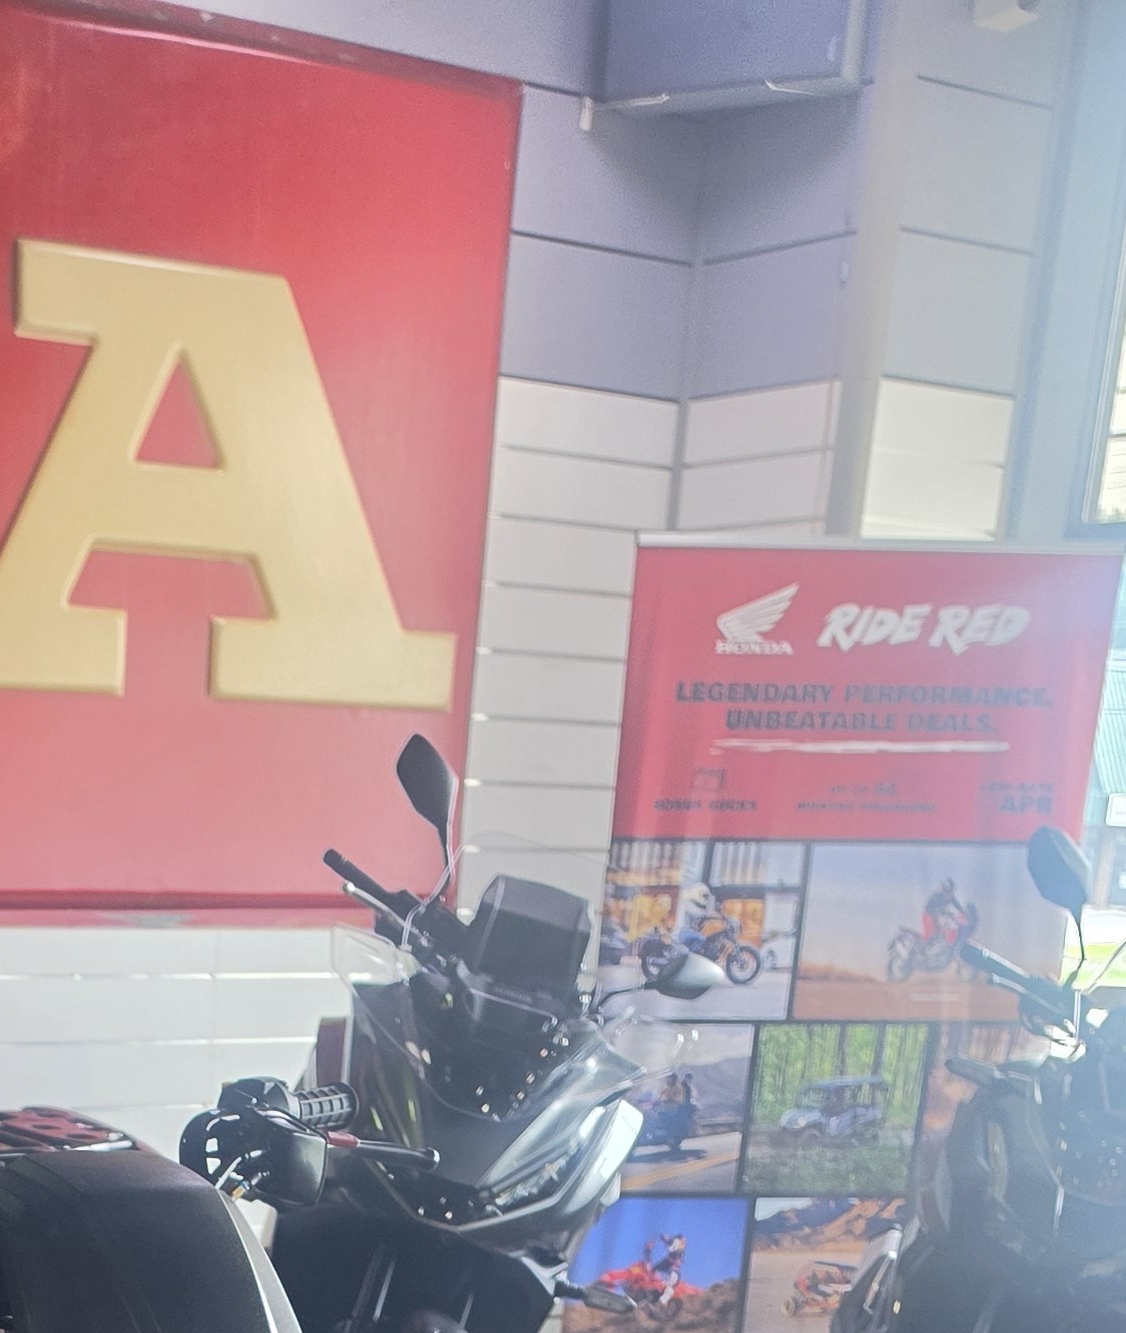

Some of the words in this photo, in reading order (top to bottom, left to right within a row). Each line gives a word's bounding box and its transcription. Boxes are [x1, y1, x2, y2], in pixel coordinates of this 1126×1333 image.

[816, 602, 934, 652] RIDE
[927, 603, 1031, 656] RED
[715, 640, 793, 655] HONDA
[675, 680, 834, 704] LEGENDARY
[725, 708, 896, 731] UNBEATABLE
